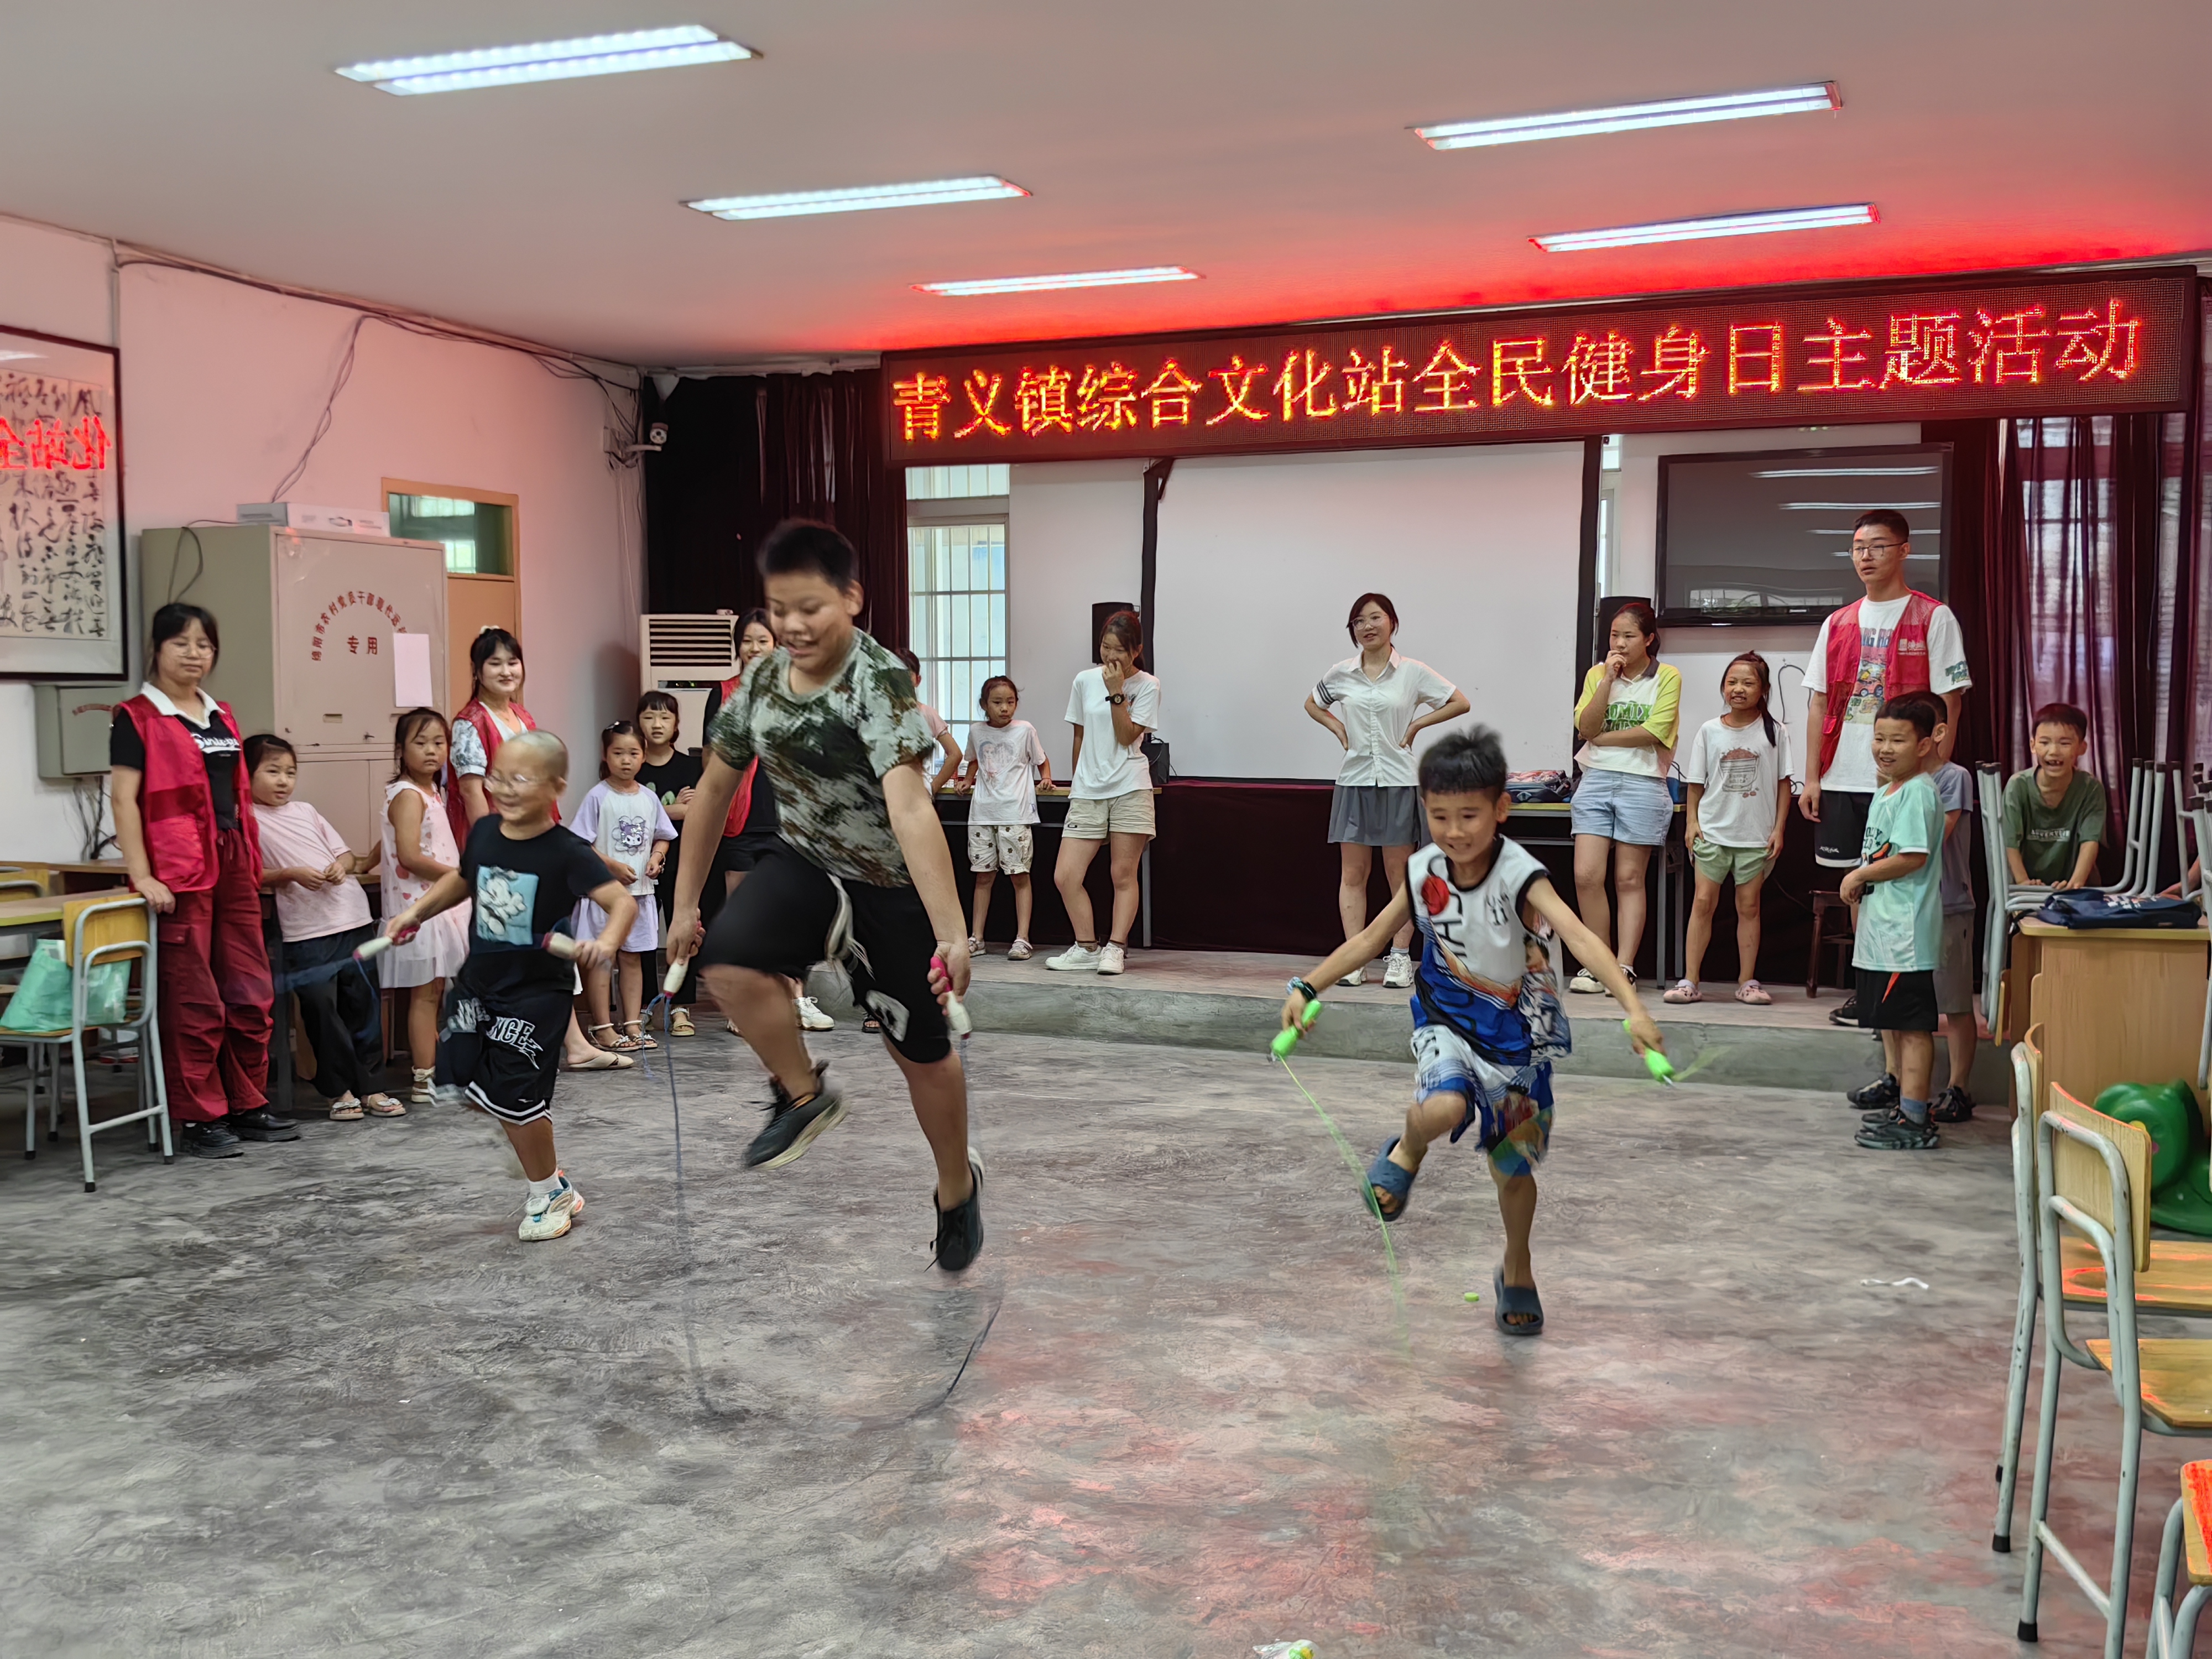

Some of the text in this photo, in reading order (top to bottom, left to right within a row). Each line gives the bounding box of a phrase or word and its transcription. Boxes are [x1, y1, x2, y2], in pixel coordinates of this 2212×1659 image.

[893, 298, 2141, 440] 青义镇综合文化站全民健身日主题活动
[347, 635, 378, 655] 专用
